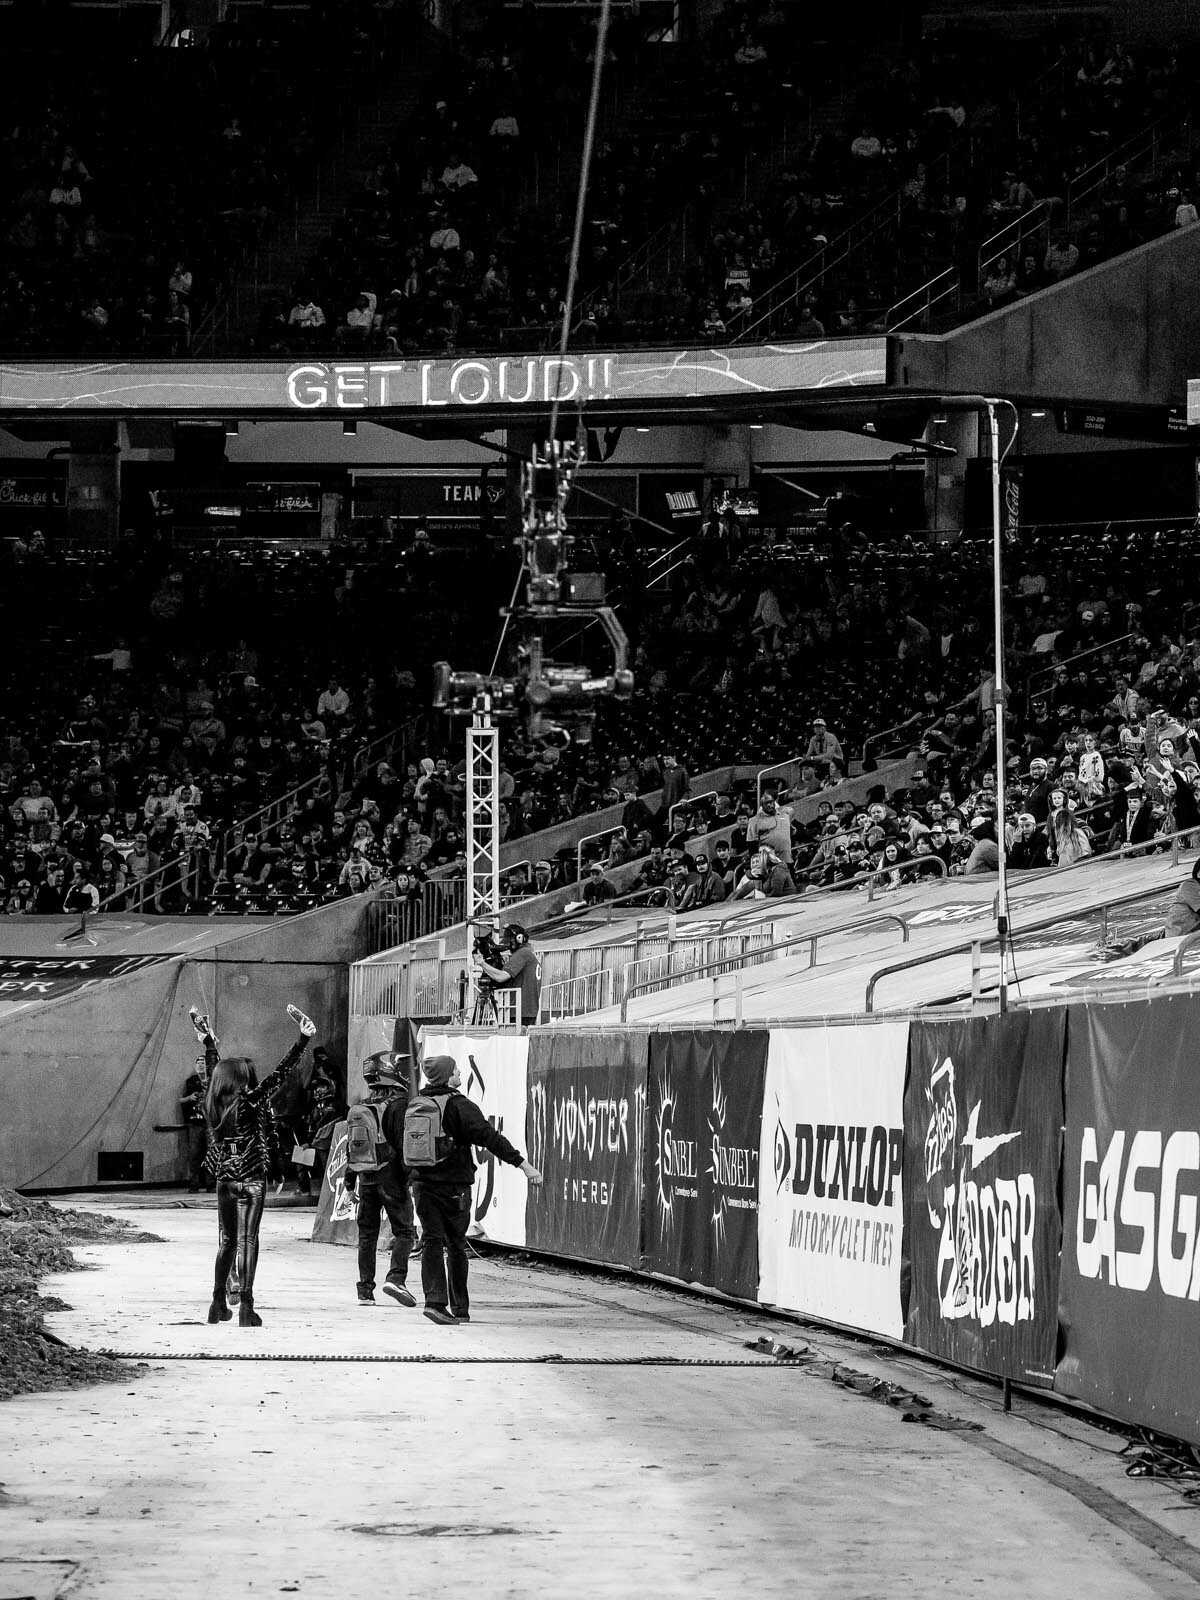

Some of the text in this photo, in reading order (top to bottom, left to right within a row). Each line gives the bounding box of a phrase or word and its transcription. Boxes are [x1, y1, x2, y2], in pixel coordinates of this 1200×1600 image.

[287, 358, 611, 408] GET LOUD!!
[553, 1084, 628, 1163] MONSTER
[792, 1123, 903, 1207] DUNLOP
[789, 1209, 894, 1268] MOTORCYCLE TIRES
